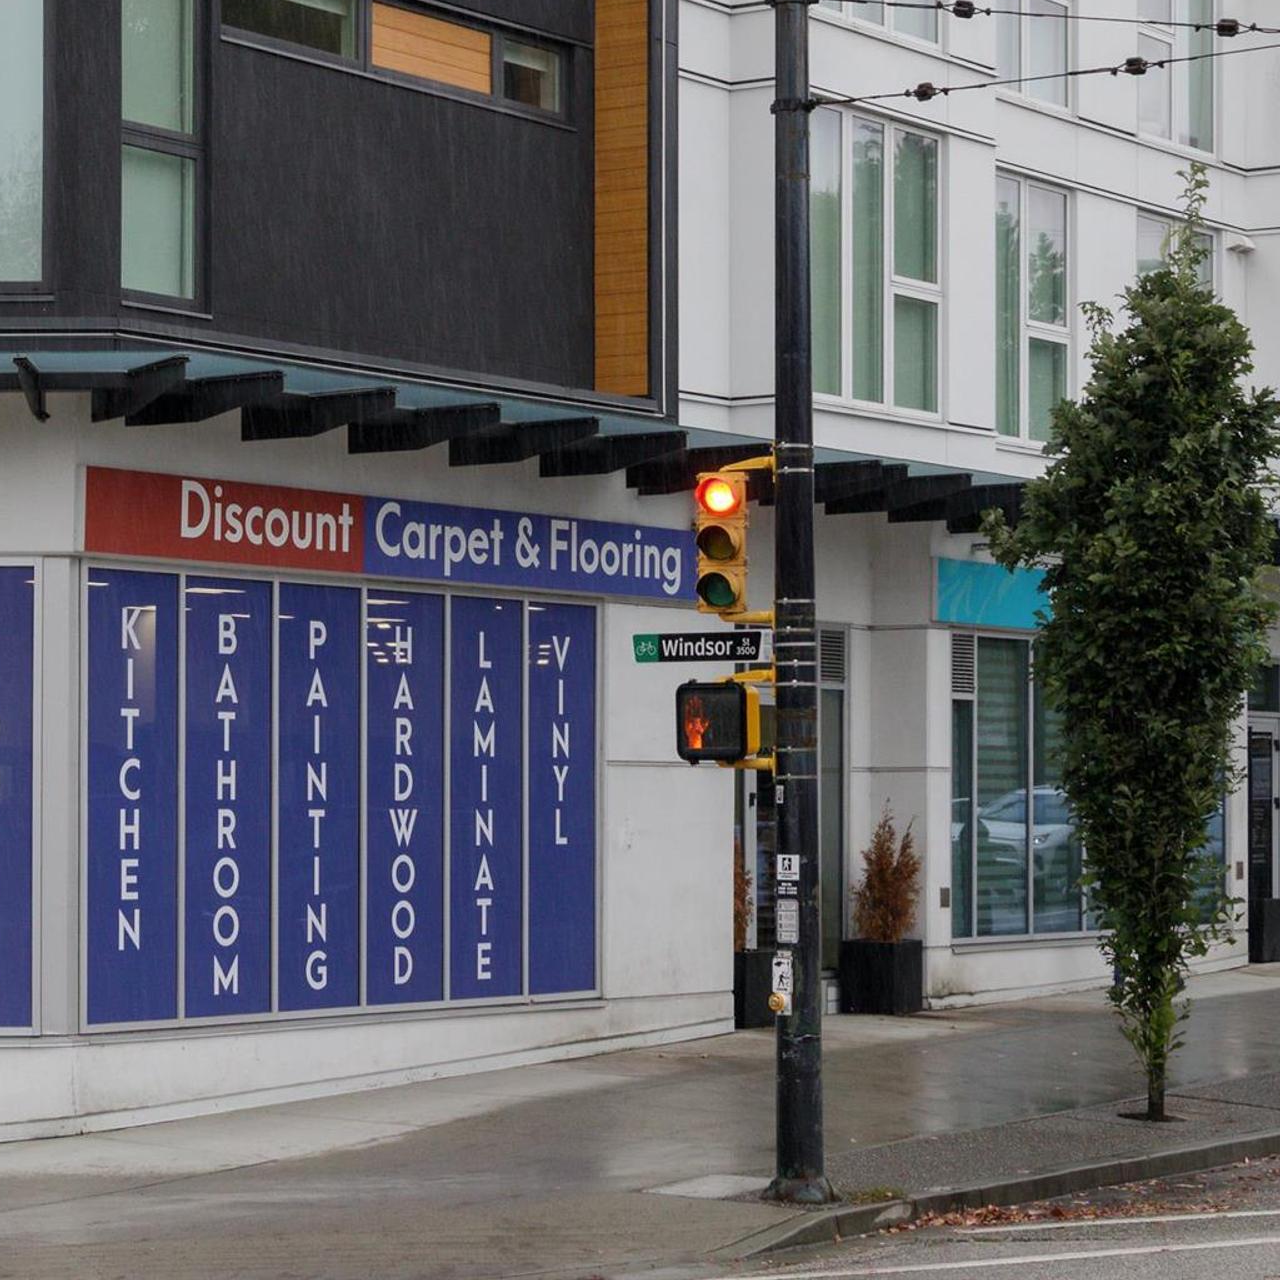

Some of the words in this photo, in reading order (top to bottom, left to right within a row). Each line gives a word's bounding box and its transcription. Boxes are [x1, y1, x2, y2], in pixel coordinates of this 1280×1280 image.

[181, 480, 353, 553] Discount
[376, 503, 504, 577] Carpet
[515, 518, 540, 568] &
[550, 515, 684, 596] Flooring
[662, 637, 733, 656] Windsor
[736, 646, 756, 656] 3500
[742, 637, 750, 646] St
[118, 605, 142, 951] KITCHEN
[213, 612, 240, 996] BATHROOM
[305, 620, 328, 990] PAINTING
[389, 625, 418, 985] HARDWOOD
[474, 631, 495, 980] LAMINATE
[551, 635, 570, 845] VINYL
